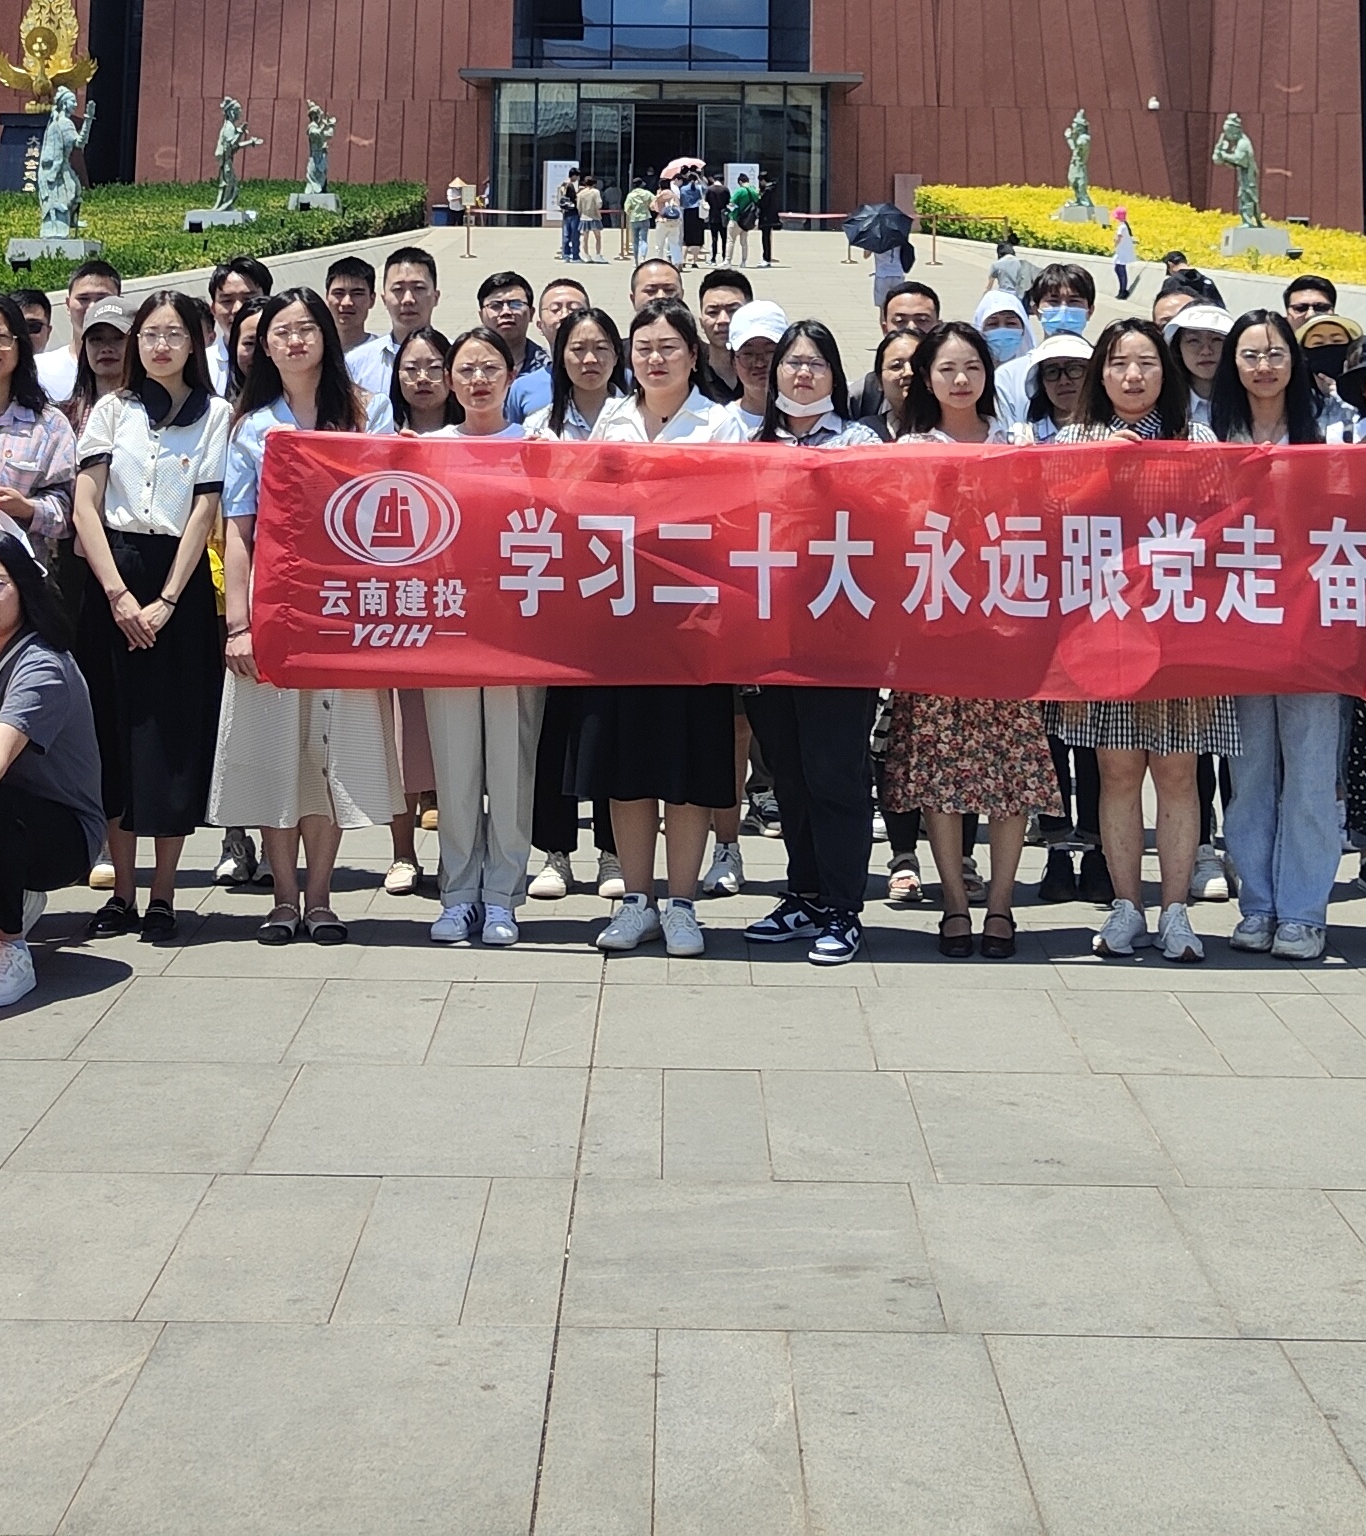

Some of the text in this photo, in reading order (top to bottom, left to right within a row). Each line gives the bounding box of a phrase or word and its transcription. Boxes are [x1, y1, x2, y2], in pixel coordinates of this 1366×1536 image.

[499, 507, 876, 620] 学习二十大
[901, 510, 1285, 625] 永远跟党走
[319, 577, 467, 618] 云南建投
[351, 623, 433, 648] YCIH
